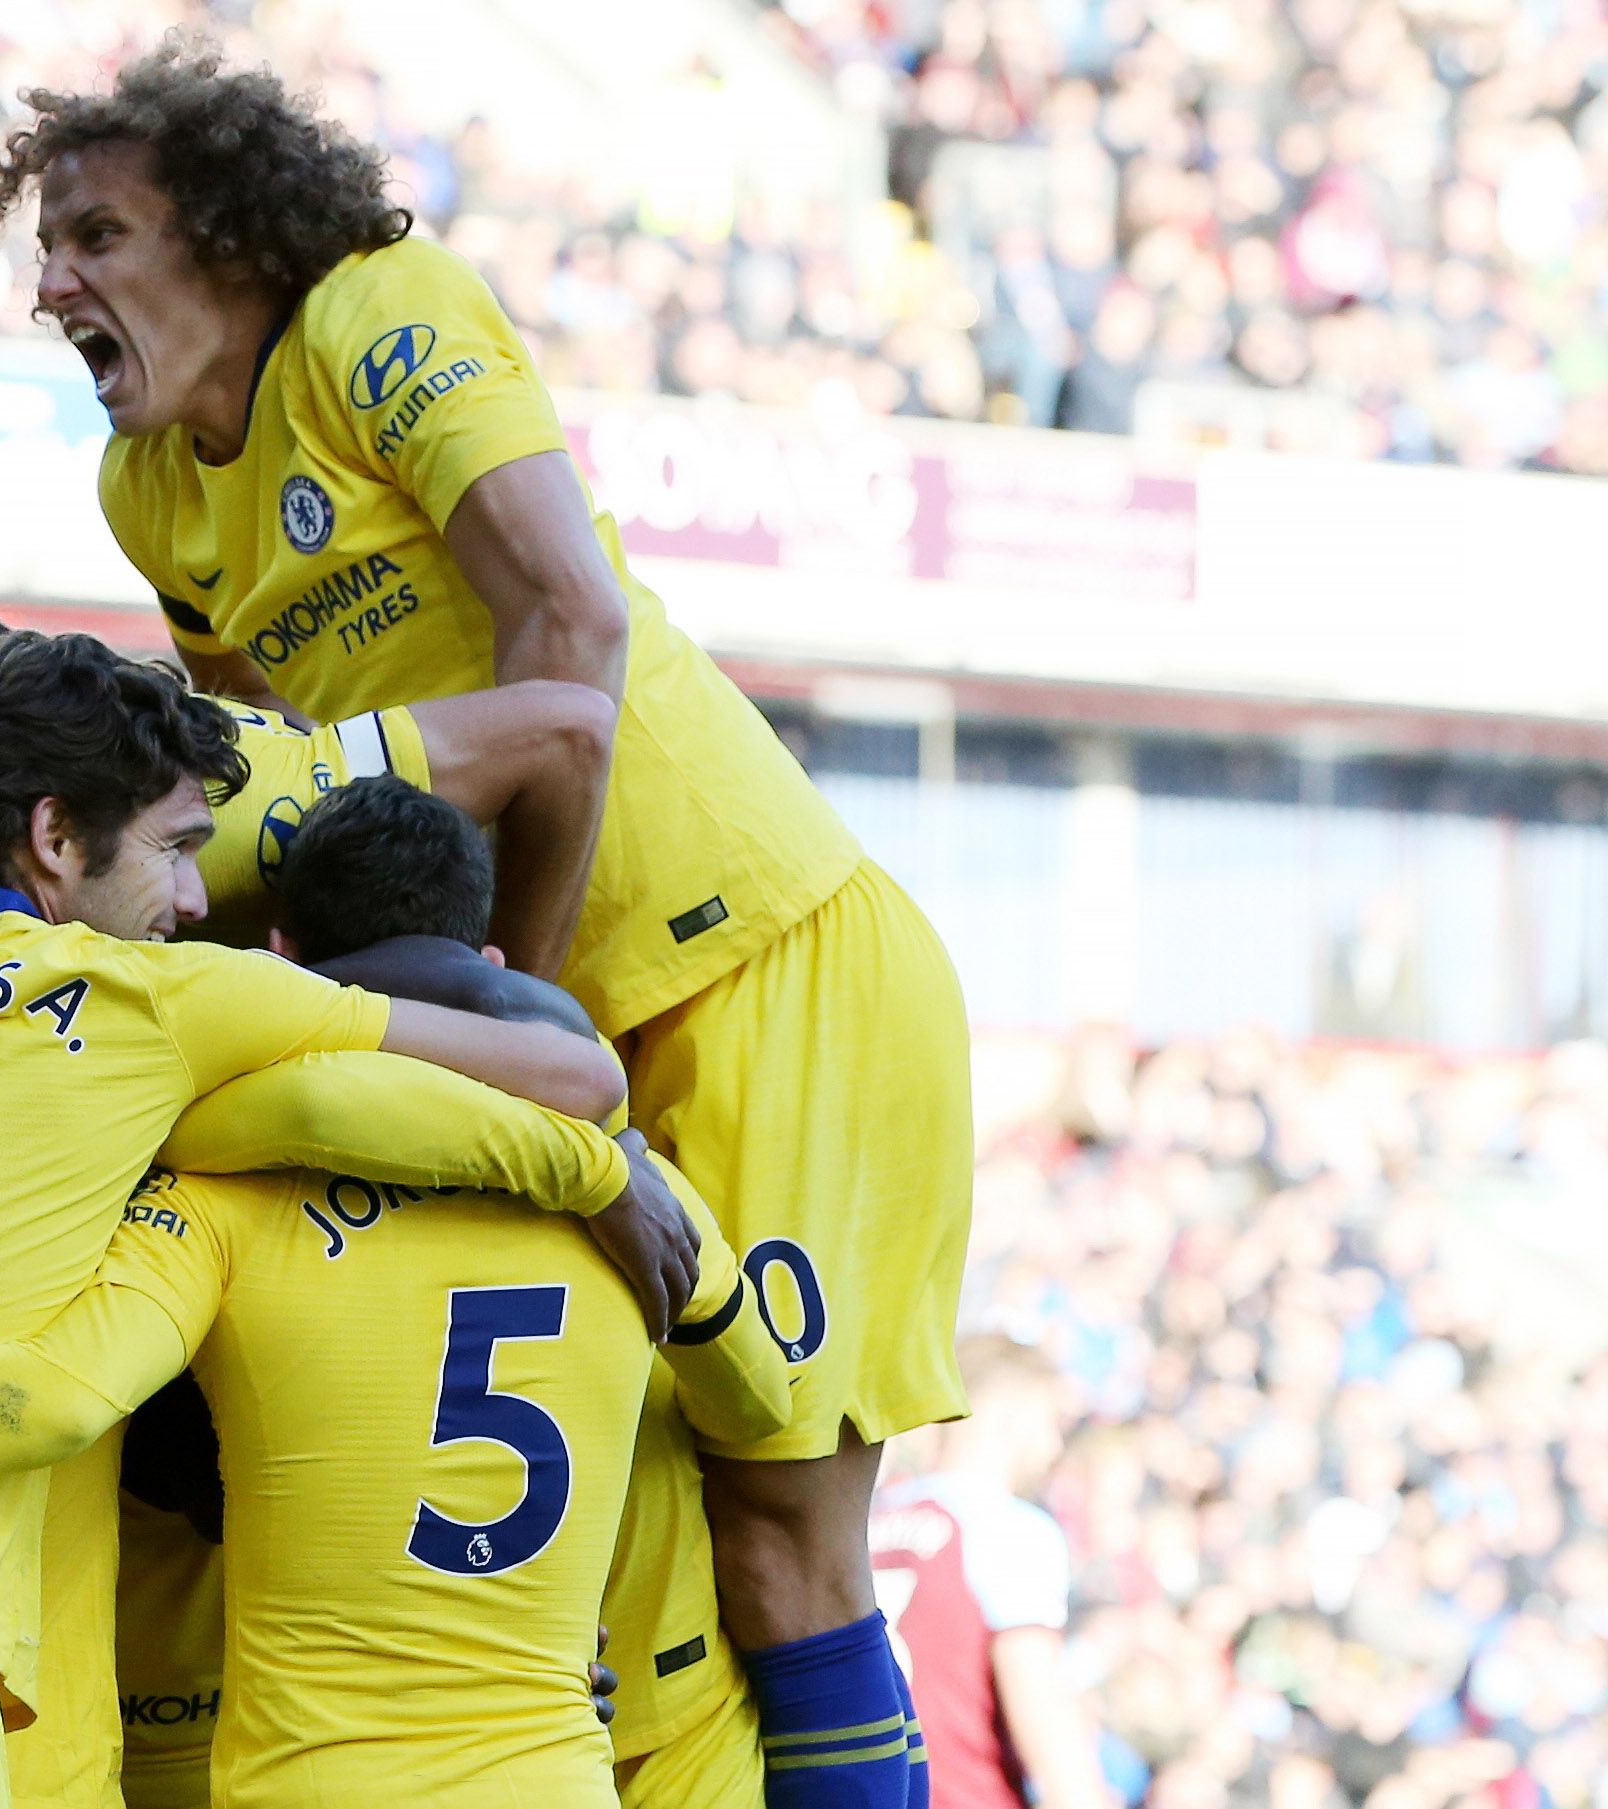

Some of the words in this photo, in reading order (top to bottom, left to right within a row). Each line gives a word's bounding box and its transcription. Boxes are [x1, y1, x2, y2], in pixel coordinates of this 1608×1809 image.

[376, 357, 486, 462] HYUNDAI
[243, 552, 403, 673] YOKOHAMA
[337, 583, 420, 655] TYRES
[24, 976, 91, 1054] A.
[404, 1283, 574, 1578] 5
[120, 1689, 220, 1725] KOH
